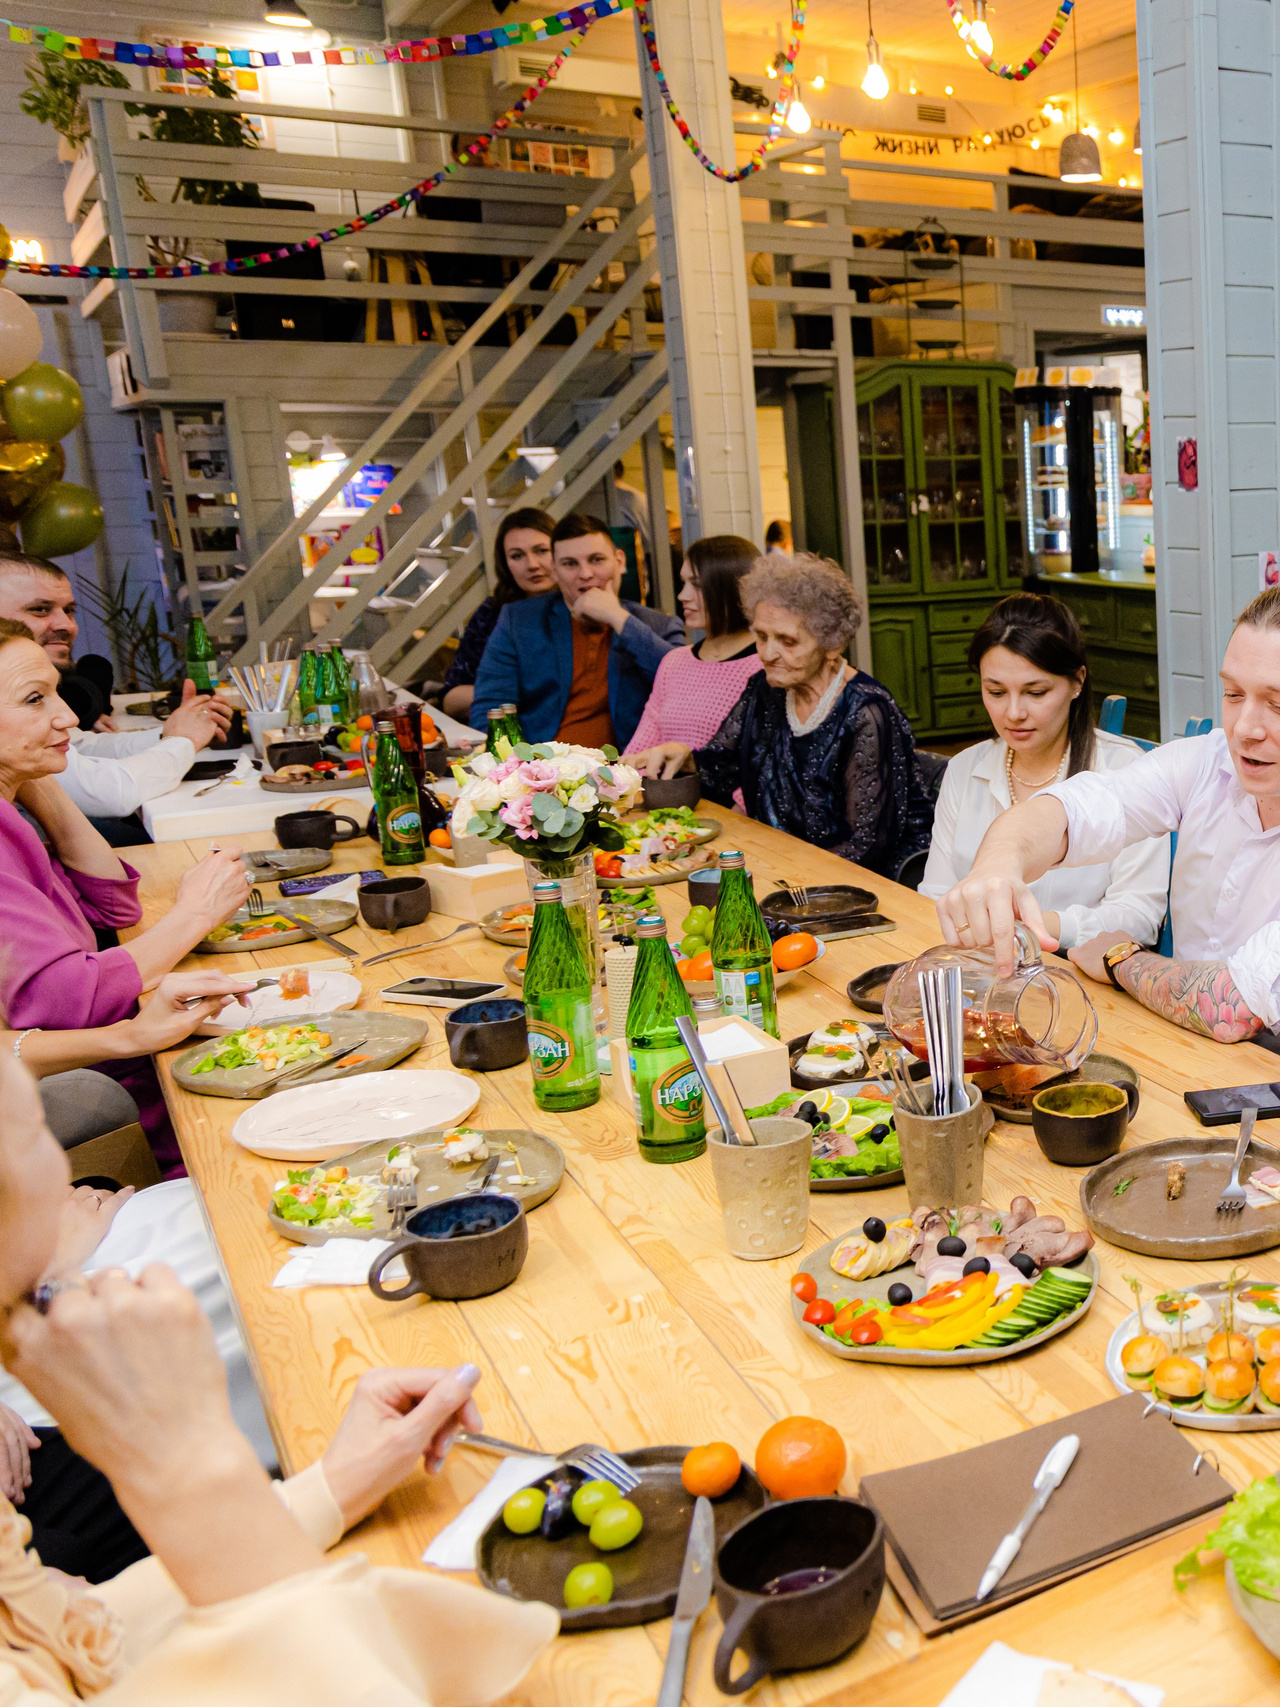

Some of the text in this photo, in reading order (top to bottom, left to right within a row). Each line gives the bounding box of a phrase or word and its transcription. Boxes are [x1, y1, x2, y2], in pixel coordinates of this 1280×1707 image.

[874, 136, 941, 155] ЖИЗНИ
[529, 1041, 570, 1058] РЗАН
[657, 1081, 704, 1105] НАРЗ
